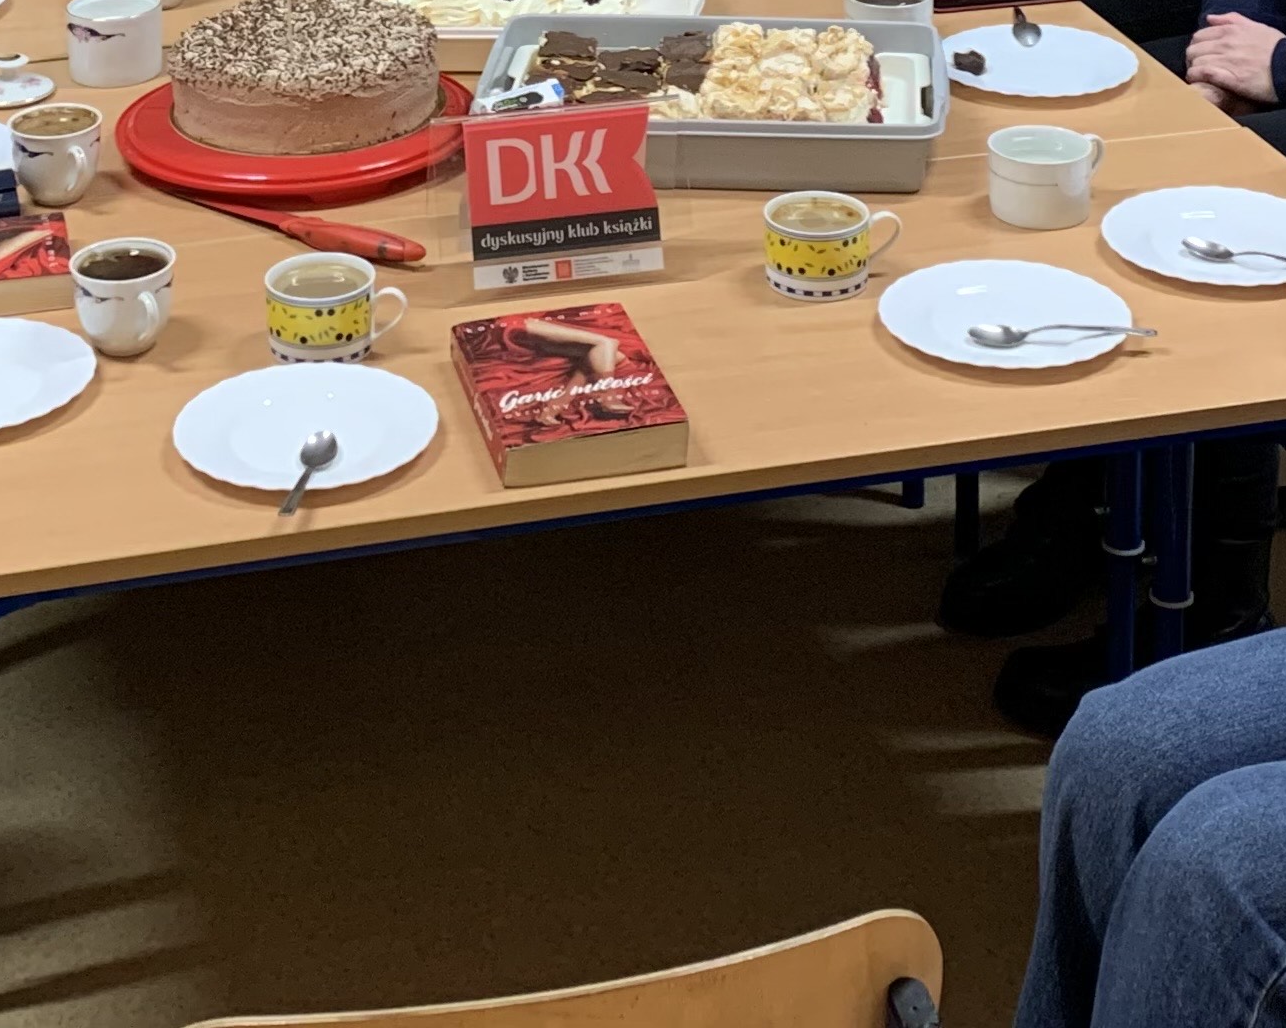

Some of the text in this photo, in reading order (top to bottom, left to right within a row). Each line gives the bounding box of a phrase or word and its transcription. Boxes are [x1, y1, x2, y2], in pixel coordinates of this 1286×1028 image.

[486, 128, 613, 206] DKK
[480, 216, 653, 250] dyskusyjny klub książki
[499, 372, 654, 413] Garść miłości
